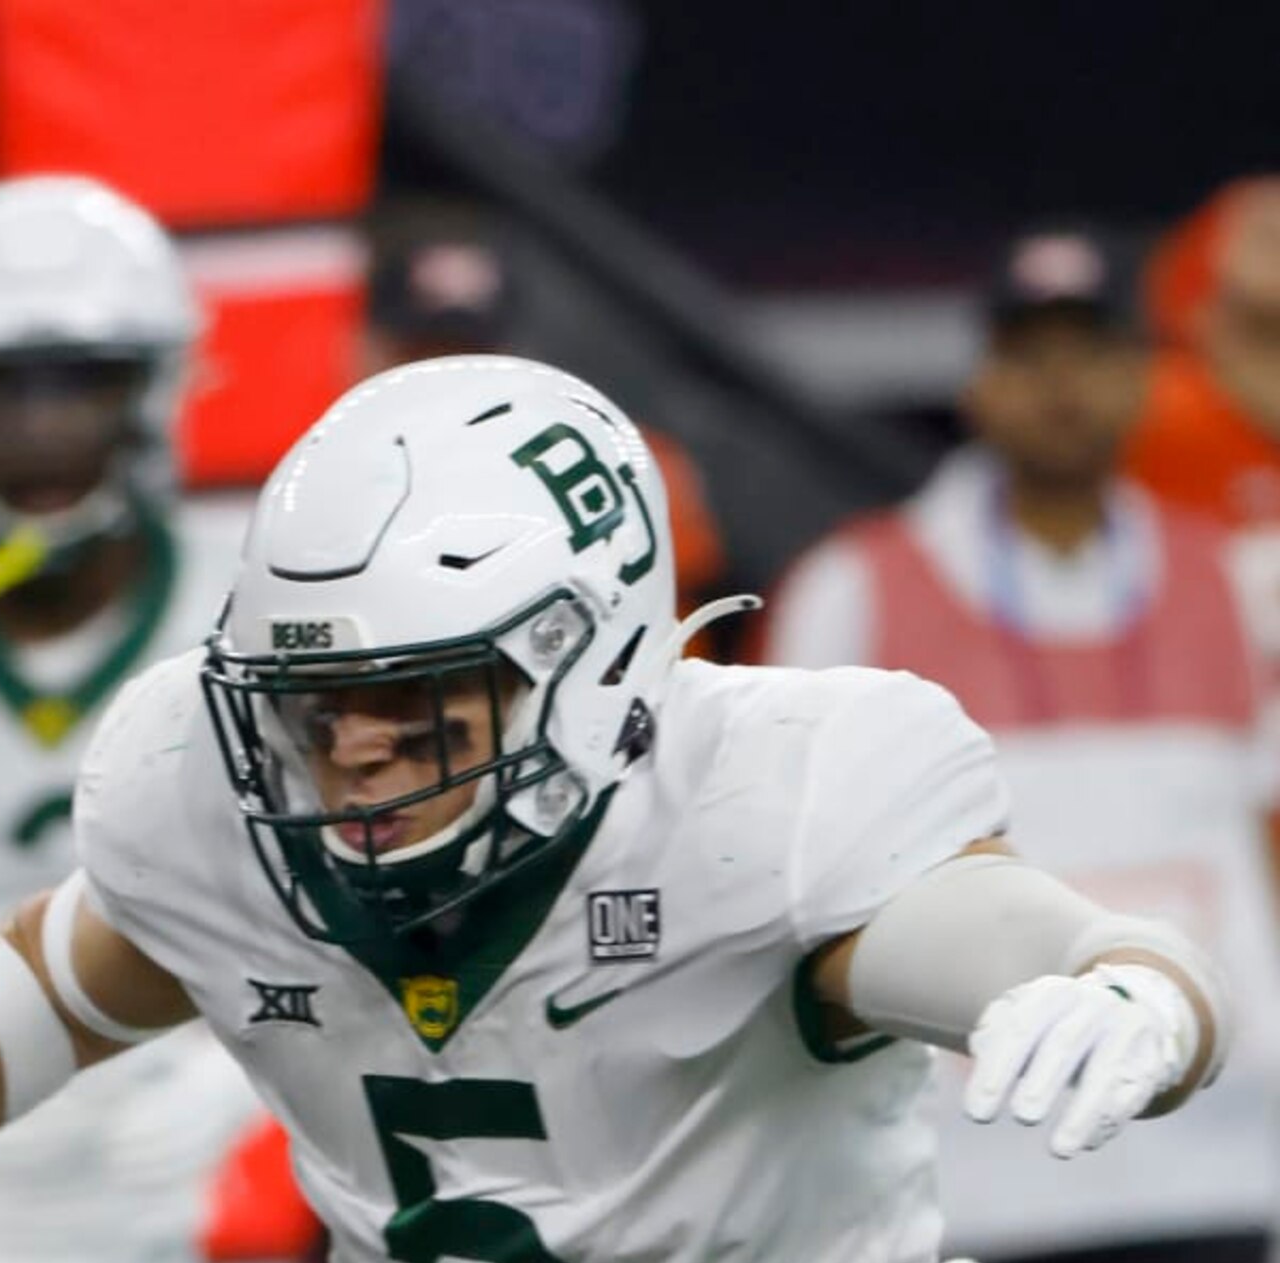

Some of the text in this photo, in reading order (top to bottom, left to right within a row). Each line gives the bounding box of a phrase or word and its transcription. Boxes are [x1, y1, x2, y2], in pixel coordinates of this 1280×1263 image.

[272, 622, 333, 649] BEARS
[593, 894, 656, 943] ONE
[246, 978, 323, 1027] XII
